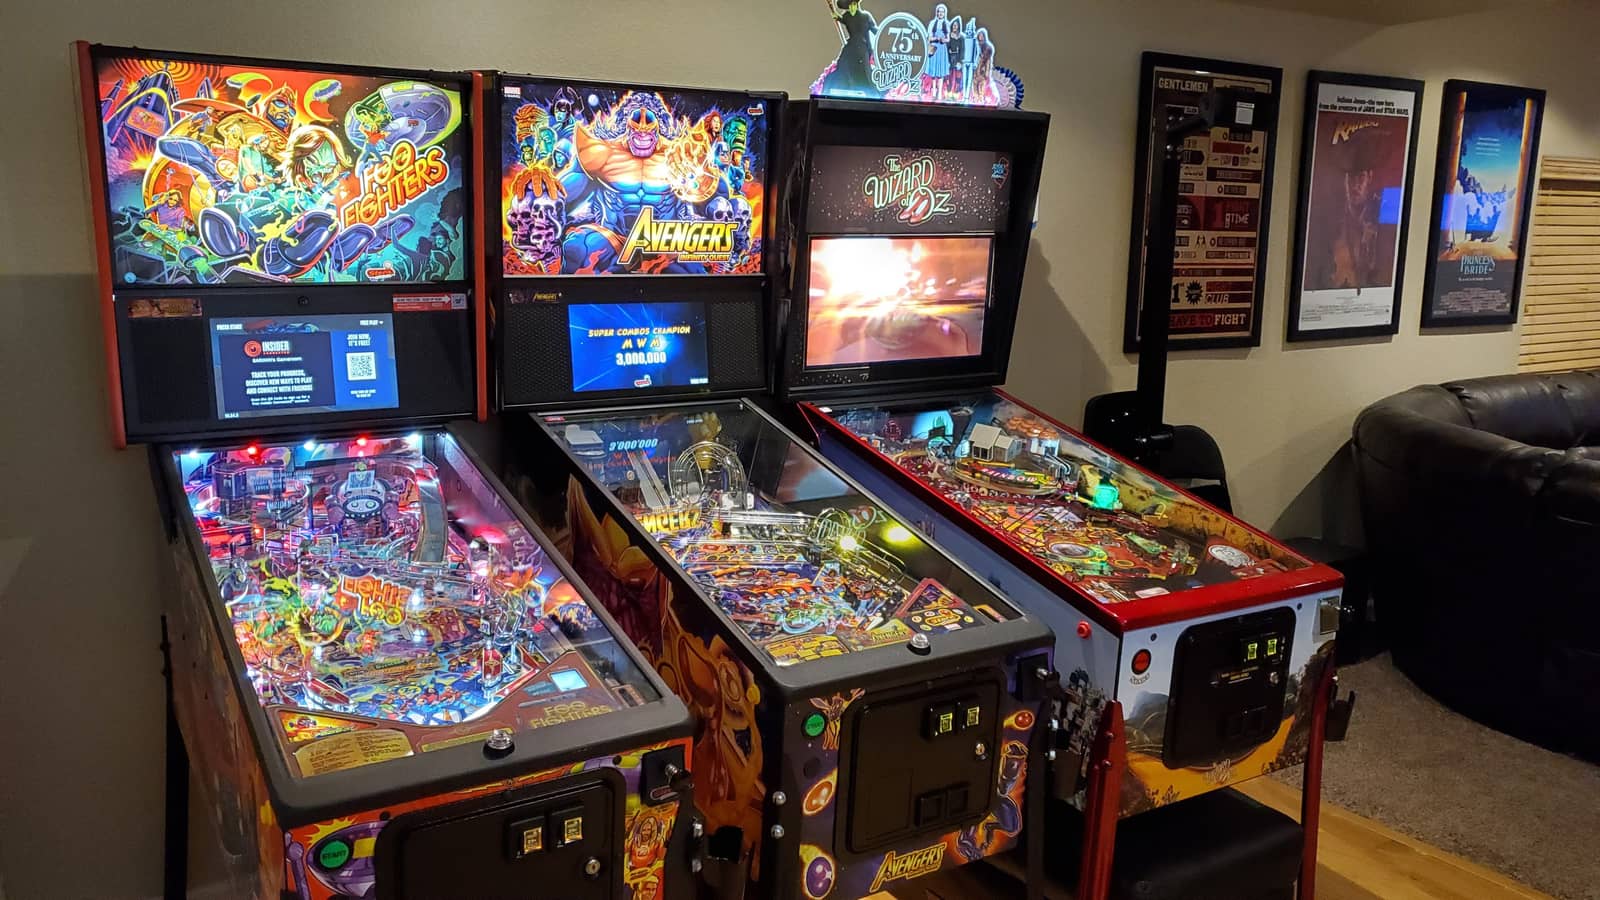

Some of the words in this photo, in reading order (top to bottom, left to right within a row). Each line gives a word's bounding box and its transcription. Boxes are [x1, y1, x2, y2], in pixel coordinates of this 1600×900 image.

[880, 51, 922, 62] ANNIVERSARY
[1158, 77, 1208, 92] GENTLEMEN
[364, 141, 416, 194] FOO
[887, 158, 900, 172] The
[343, 149, 446, 228] FIGHTERS
[865, 160, 933, 208] WIZARD
[1231, 213, 1250, 224] TIME
[619, 207, 738, 263] AVENGERS
[1460, 255, 1495, 272] PRINCESS
[1464, 265, 1488, 275] BRIDE
[1206, 294, 1230, 304] CLUB
[1214, 313, 1246, 326] FIGHT
[588, 328, 614, 337] SUPER
[617, 327, 650, 336] COMBOS
[653, 326, 690, 335] CHAMPION
[262, 341, 289, 351] INSIDER
[622, 339, 632, 349] M
[637, 338, 647, 348] W
[650, 337, 660, 347] M
[616, 352, 667, 366] 3,000,000
[246, 379, 268, 387] DISCOVER
[257, 386, 278, 394] CONNECT
[981, 468, 1037, 482] RAINBOW
[543, 701, 586, 716] FOO
[322, 850, 347, 860] START
[871, 845, 945, 890] AVENGERS
